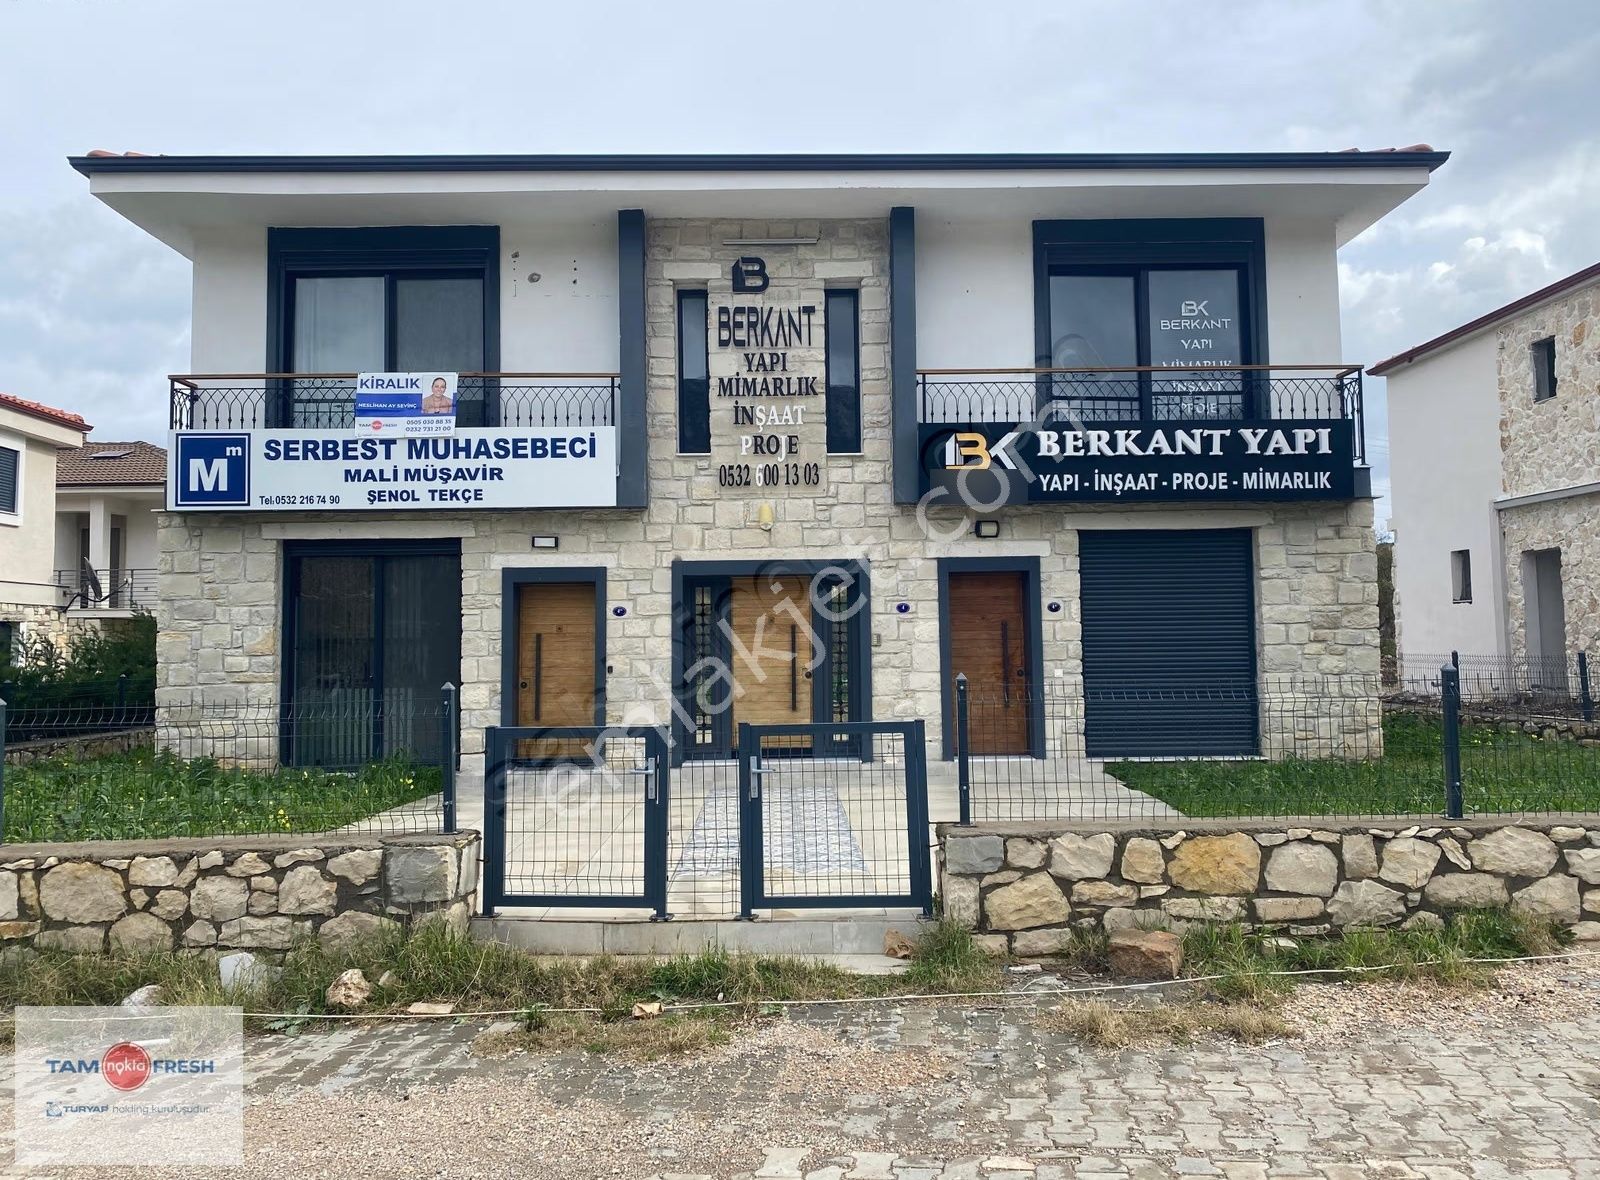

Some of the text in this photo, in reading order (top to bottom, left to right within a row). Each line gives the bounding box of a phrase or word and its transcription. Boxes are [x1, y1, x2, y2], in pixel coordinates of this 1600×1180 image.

[718, 305, 816, 347] BERKANT
[1160, 319, 1231, 329] BERKANT
[1181, 339, 1212, 349] YAPI
[743, 352, 787, 372] YAPI
[360, 376, 420, 389] KİRALIK
[717, 372, 819, 397] MİMARLIK
[733, 400, 807, 432] İNŞAAT
[263, 432, 597, 461] SERBEST MUHASEBECİ
[740, 434, 799, 462] PROJE
[1036, 428, 1333, 457] BERKANT YAPI
[344, 464, 504, 484] MALİ MÜŞAVİR
[719, 462, 820, 487] 0532 600 13 03
[1039, 474, 1079, 491] YAPI
[1095, 469, 1158, 496] İNŞAAT
[1172, 473, 1228, 490] PROJE
[1243, 467, 1332, 489] MİMARLIK
[300, 496, 315, 504] 216
[317, 496, 326, 504] 74
[329, 495, 340, 504] 90
[367, 489, 483, 505] ŞENOL TEKÇE
